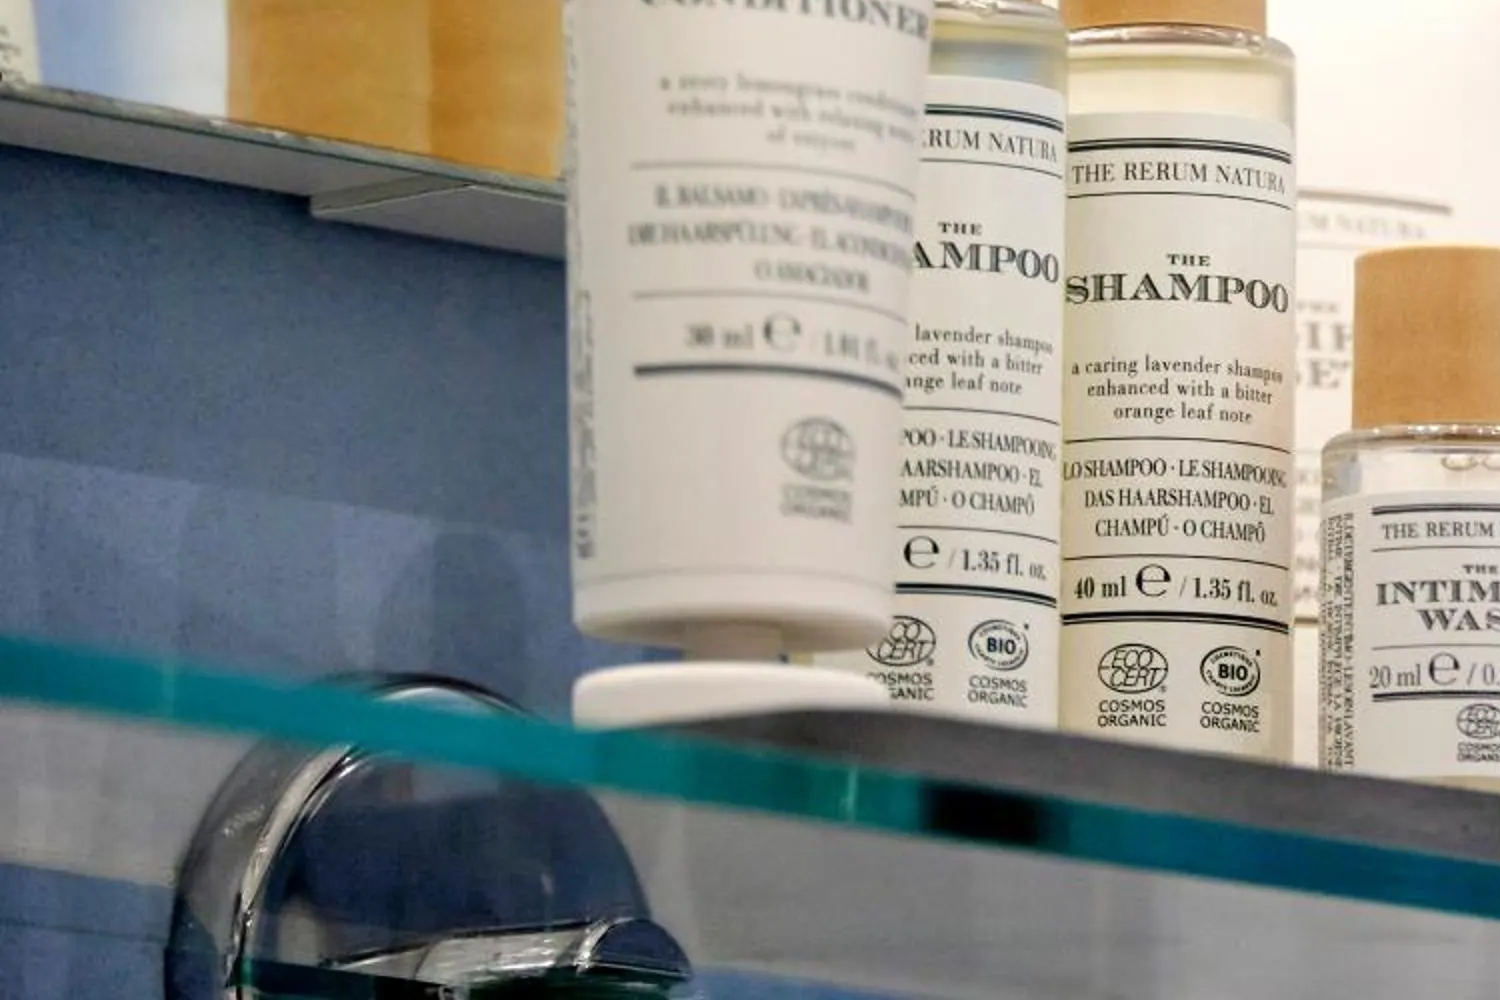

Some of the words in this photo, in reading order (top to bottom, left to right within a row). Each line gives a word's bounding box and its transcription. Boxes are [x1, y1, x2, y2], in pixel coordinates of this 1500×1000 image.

[989, 132, 1058, 162] NATURA
[1072, 162, 1115, 184] THE
[1124, 161, 1207, 182] RERUM
[1216, 164, 1285, 195] NATURA
[938, 221, 982, 236] THE
[912, 241, 1059, 284] AMPOO
[1167, 253, 1211, 267] THE
[1065, 273, 1289, 313] SHAMPOO
[915, 323, 992, 345] lavender
[947, 351, 985, 368] with
[991, 357, 1000, 369] a
[1006, 354, 1043, 376] bitter
[1072, 364, 1080, 376] a
[1085, 357, 1138, 377] caring
[1145, 354, 1221, 374] lavender
[951, 372, 985, 391] leaf
[990, 379, 1022, 396] note
[1087, 378, 1169, 397] enhanced
[1177, 380, 1215, 398] with
[1221, 387, 1230, 399] a
[1236, 383, 1273, 404] bitter
[1113, 405, 1175, 424] orange
[1181, 402, 1215, 420] leaf
[1220, 407, 1252, 424] note
[901, 458, 1019, 484] AARSHAMPOO
[1084, 457, 1167, 478] SHAMPOO
[1179, 458, 1199, 478] LE
[952, 491, 966, 508] O
[1085, 489, 1115, 509] DAS
[1119, 487, 1250, 511] HAARSHAMPOO
[1259, 495, 1274, 516] EL
[1095, 512, 1169, 537] CHAMPÚ
[1183, 519, 1197, 537] O
[1382, 522, 1419, 540] THE
[1426, 520, 1494, 539] RERUM
[962, 548, 1000, 572] 1.35
[1462, 564, 1499, 574] THE
[1074, 576, 1095, 599] 40
[1102, 575, 1127, 598] ml
[1193, 577, 1231, 600] 1.35
[987, 637, 1016, 655] BIO
[1111, 649, 1154, 668] ECO
[1110, 667, 1160, 687] CERT
[1218, 663, 1248, 681] BIO
[1369, 665, 1391, 689] 20
[1397, 663, 1421, 687] ml
[968, 674, 1028, 693] COSMOS
[967, 689, 1028, 708] ORGANIC
[1099, 699, 1165, 713] COSMOS
[1097, 713, 1167, 727] ORGANIC
[1201, 701, 1260, 719] COSMOS
[1199, 716, 1261, 733] ORGANIC
